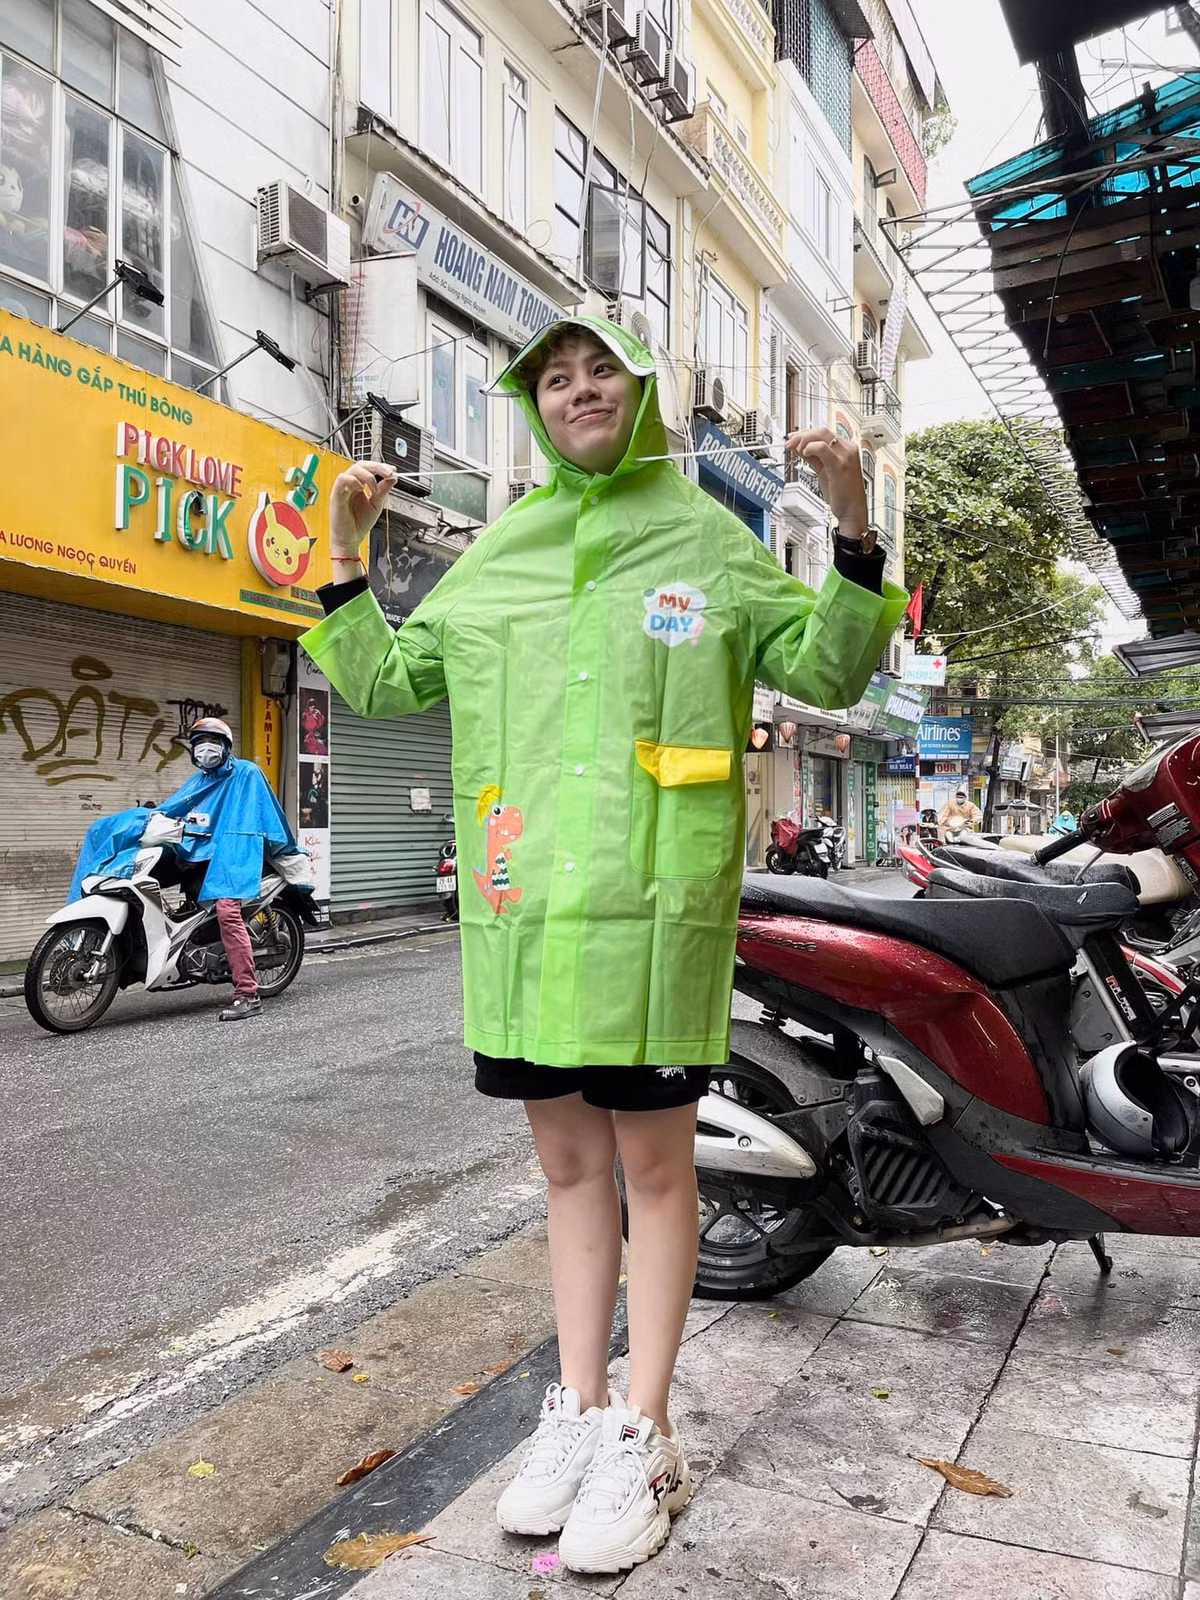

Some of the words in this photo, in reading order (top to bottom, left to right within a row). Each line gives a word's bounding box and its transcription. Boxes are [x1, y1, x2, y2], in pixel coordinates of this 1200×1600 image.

[434, 226, 485, 293] HOANG
[484, 264, 518, 316] NAM
[517, 287, 563, 332] TOUR
[18, 342, 72, 377] HÀNG
[77, 366, 113, 393] GẮP
[117, 383, 146, 408] THÚ
[150, 396, 192, 425] BÔNG
[115, 463, 235, 560] PICK
[10, 532, 54, 554] LƯƠNG
[57, 545, 95, 568] NGỌC
[264, 700, 272, 766] FAMILY
[915, 724, 961, 741] Airlines
